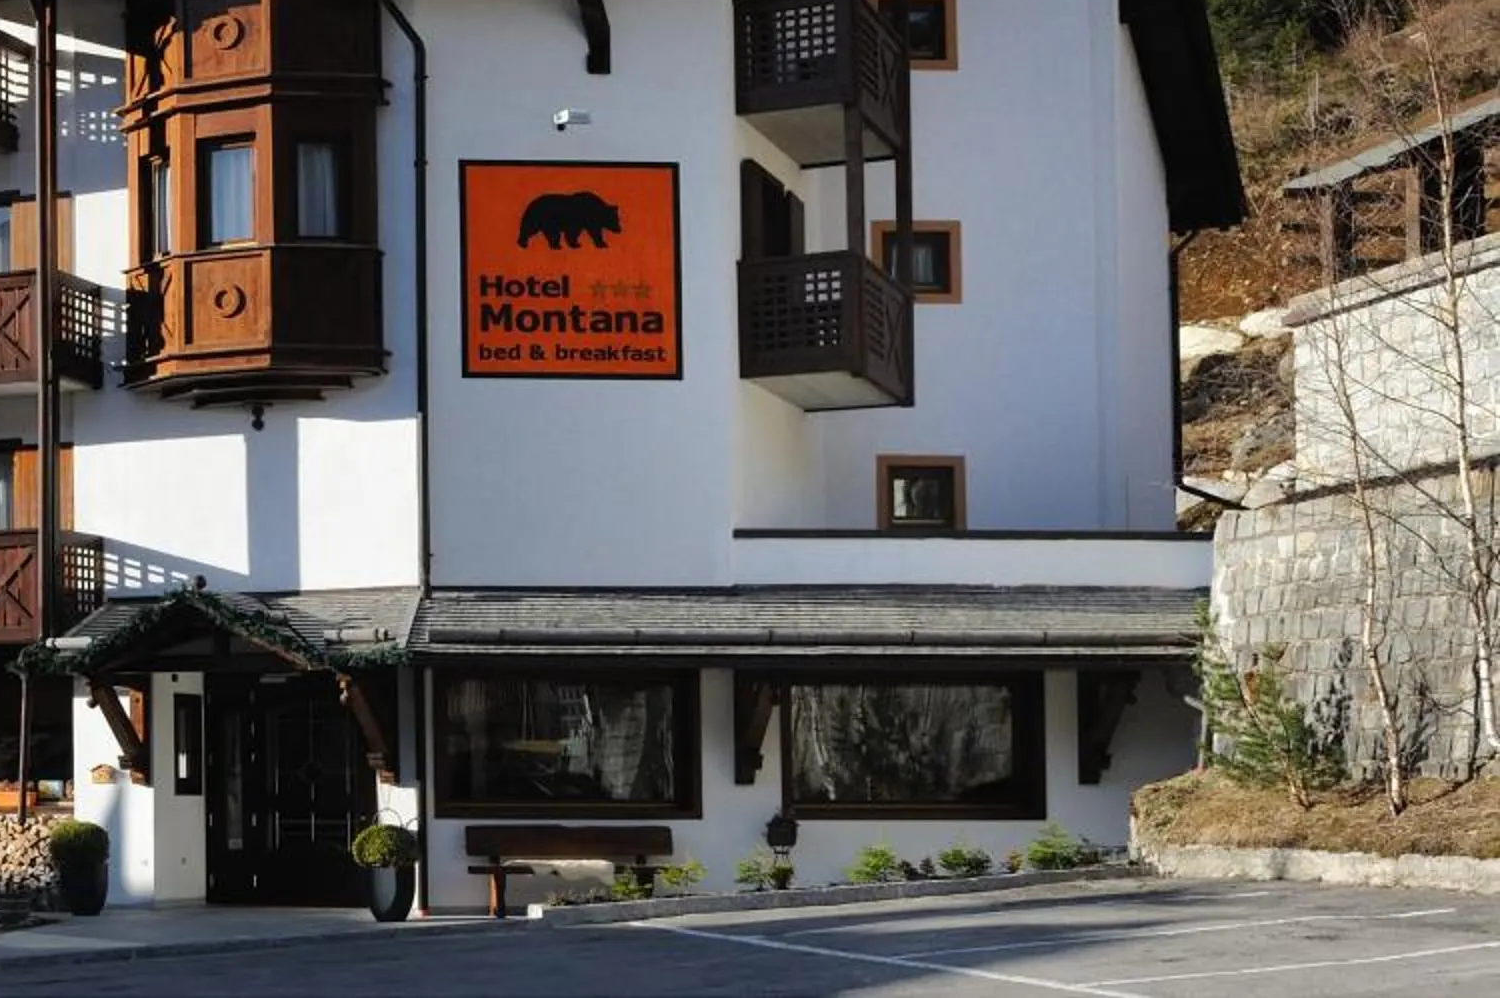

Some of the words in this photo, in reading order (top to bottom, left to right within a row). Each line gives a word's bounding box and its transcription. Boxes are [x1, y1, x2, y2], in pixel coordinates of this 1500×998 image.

[479, 275, 569, 298] Hotel
[480, 303, 664, 333] Montana
[479, 344, 521, 361] bed
[529, 345, 546, 361] &
[556, 344, 667, 363] breakfast
